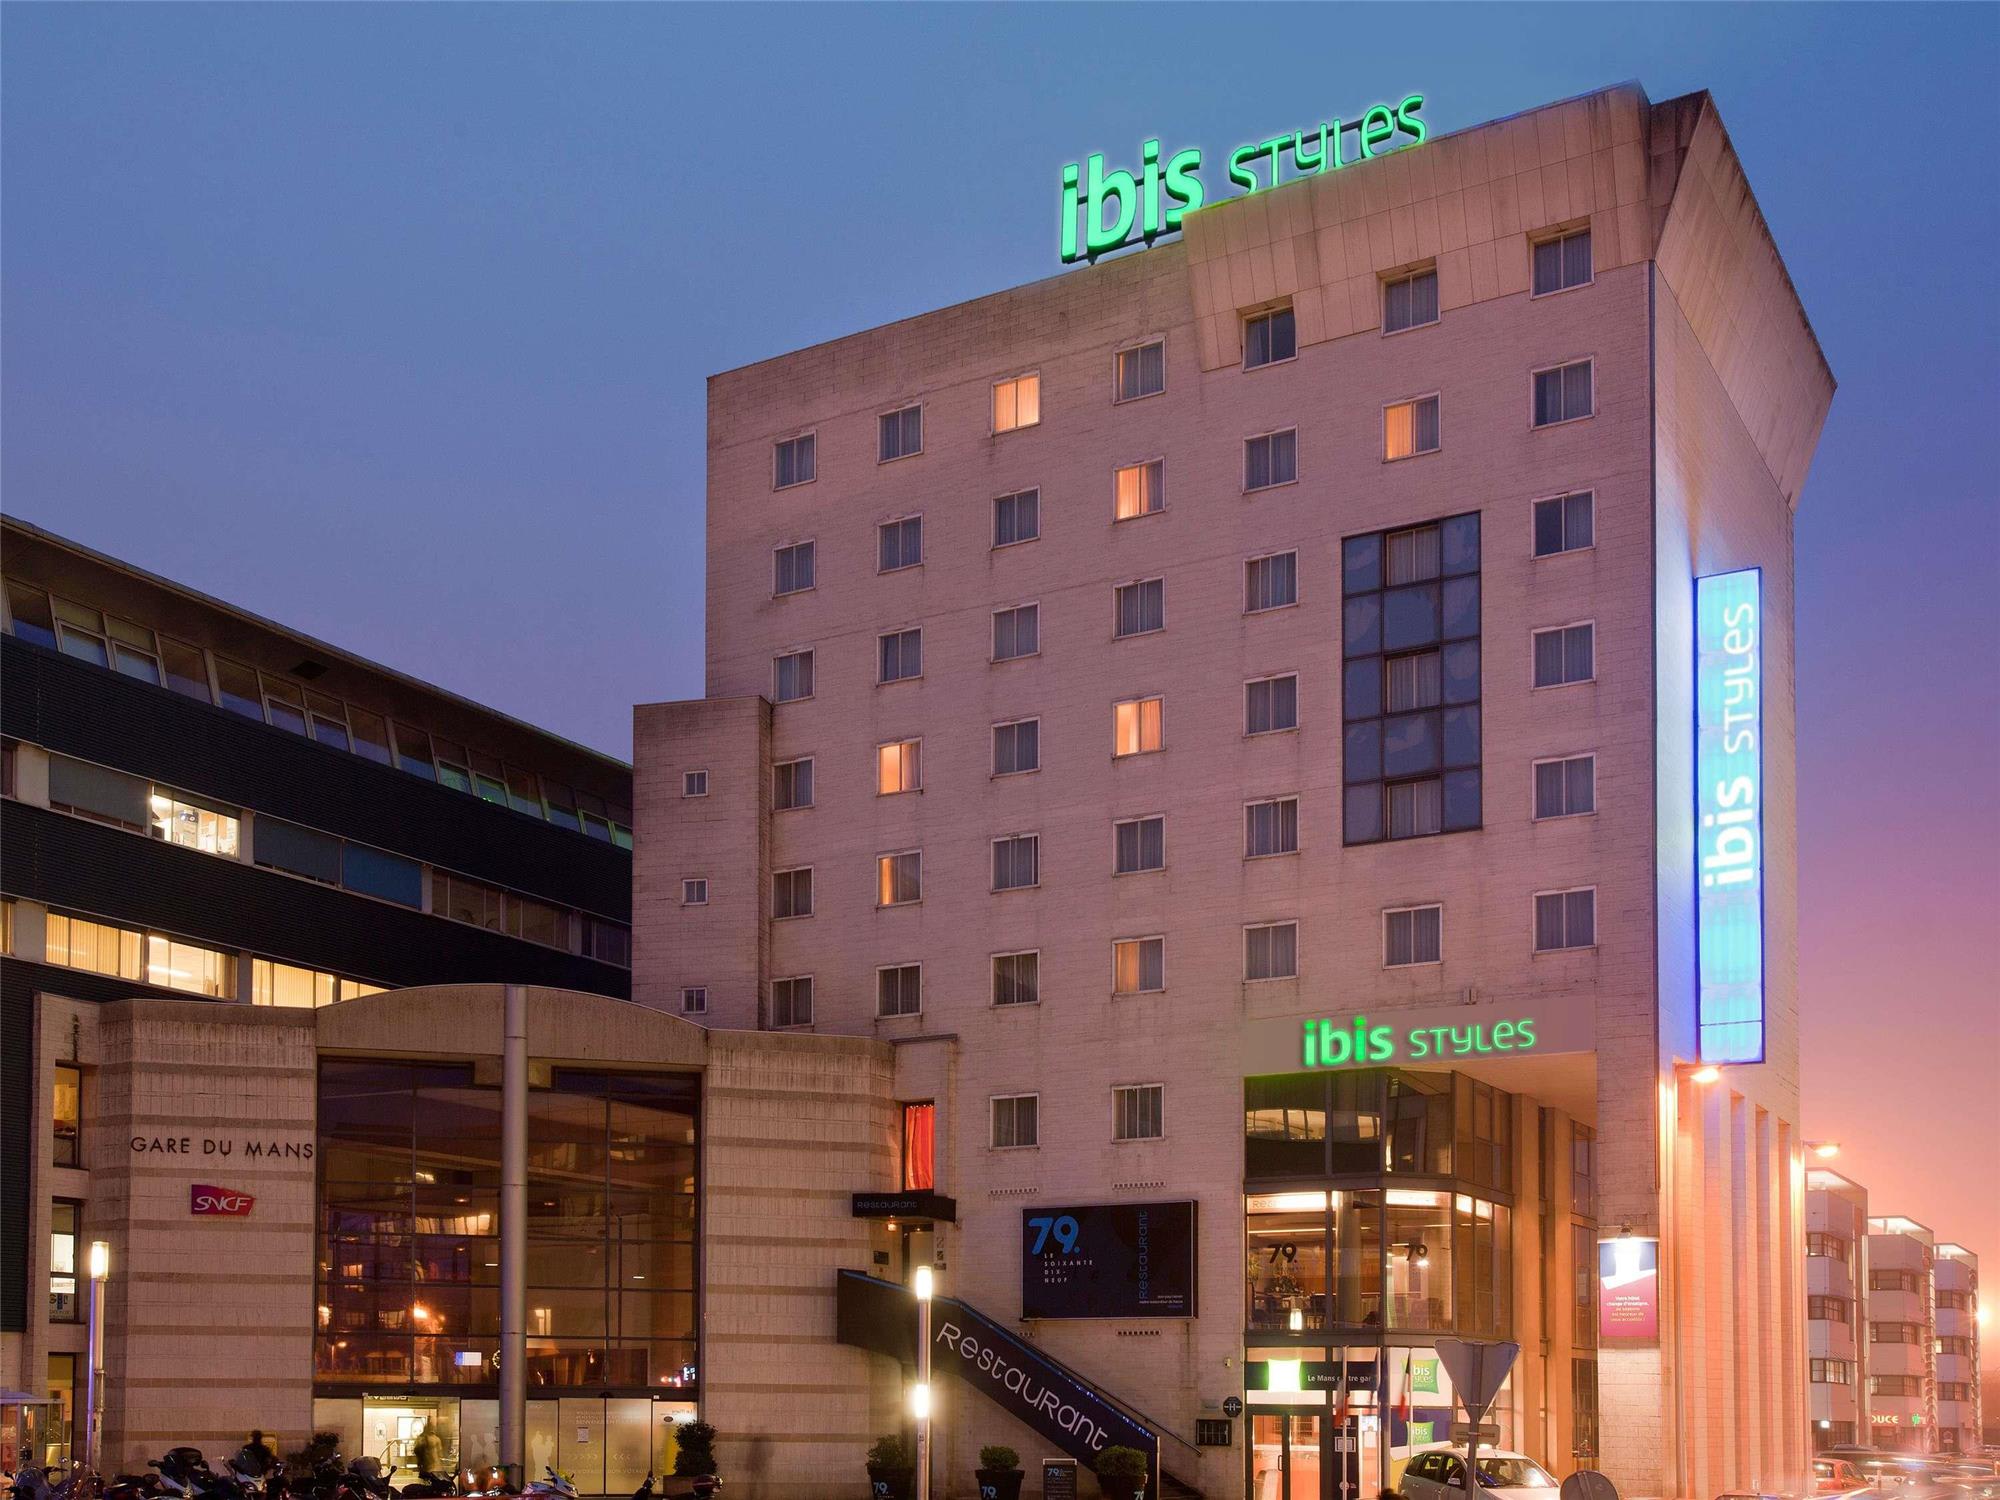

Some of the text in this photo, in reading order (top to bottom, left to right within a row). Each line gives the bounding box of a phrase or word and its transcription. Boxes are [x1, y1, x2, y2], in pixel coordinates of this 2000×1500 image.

[1060, 138, 1205, 264] ibis
[1703, 774, 1754, 888] ibis
[1302, 1015, 1395, 1067] ibis
[130, 1136, 314, 1159] GARE DU MANS
[194, 1195, 249, 1211] SNCF
[1044, 1259, 1093, 1267] SOIXANTE
[1307, 1374, 1316, 1382] Le
[1317, 1374, 1336, 1382] Mans
[1337, 1374, 1359, 1382] ctre
